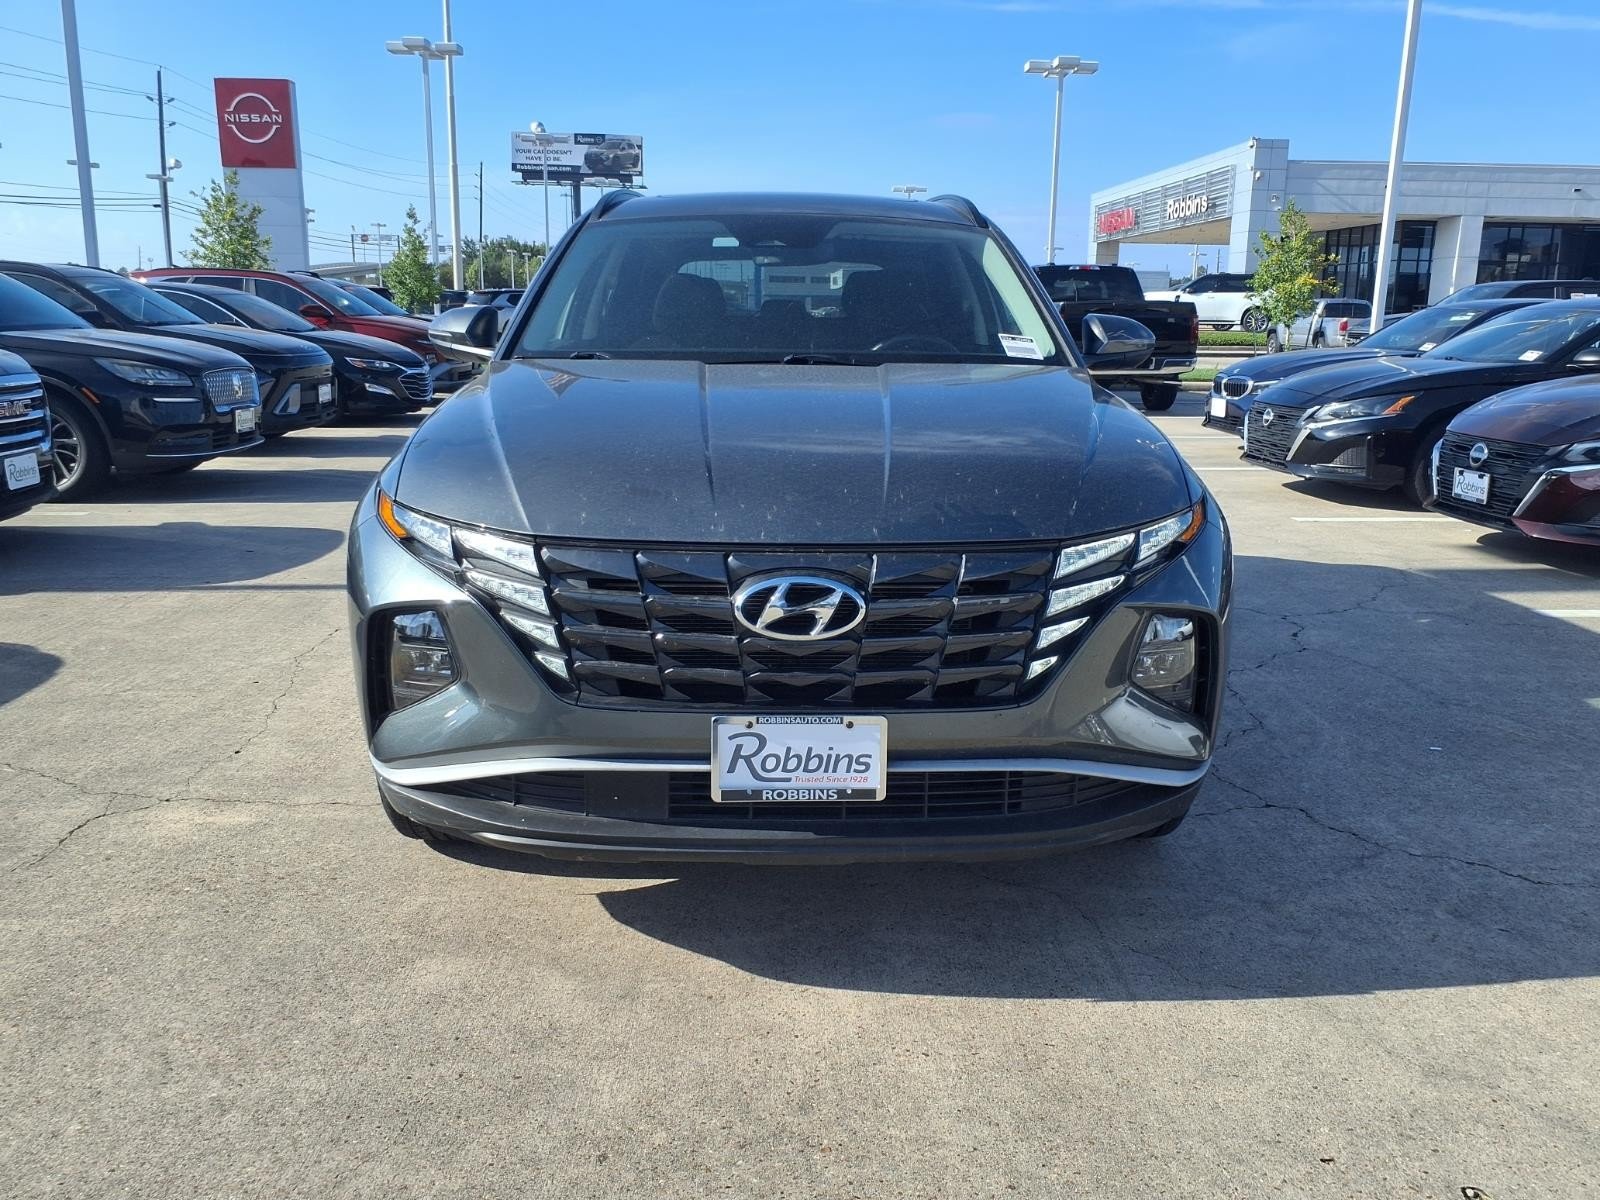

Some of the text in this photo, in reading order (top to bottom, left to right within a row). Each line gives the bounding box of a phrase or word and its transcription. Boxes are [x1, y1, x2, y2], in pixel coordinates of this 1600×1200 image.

[224, 113, 282, 123] NISSAN
[1166, 194, 1208, 220] Robbins
[8, 463, 37, 481] Robbins
[1456, 475, 1486, 495] Robbins
[727, 732, 873, 782] Robbins
[762, 789, 838, 800] ROBBINS
